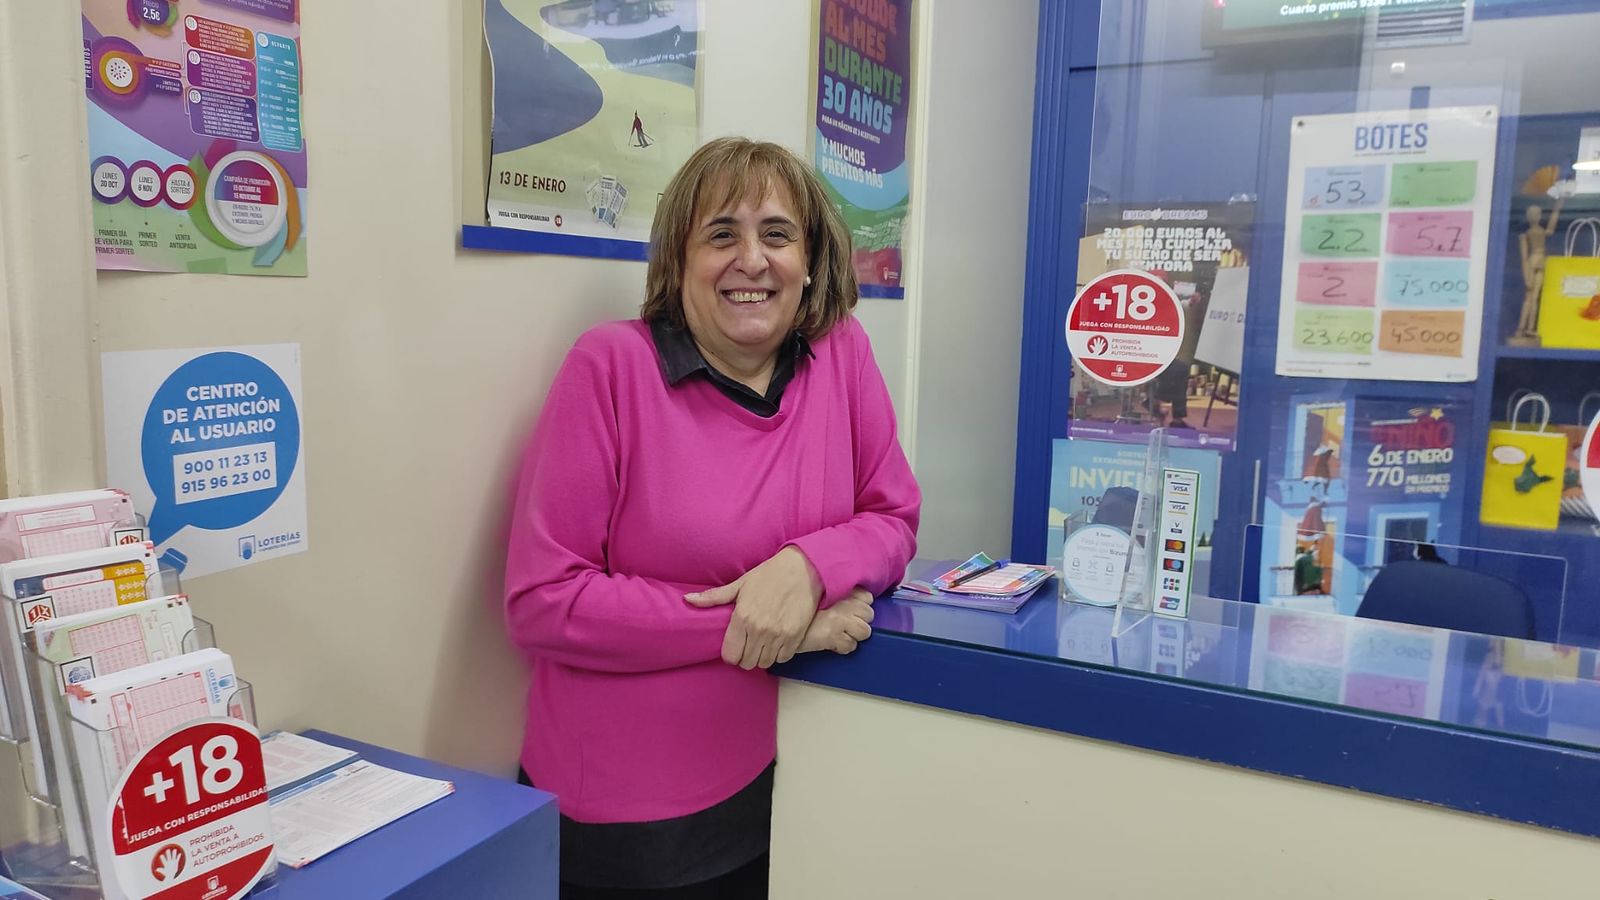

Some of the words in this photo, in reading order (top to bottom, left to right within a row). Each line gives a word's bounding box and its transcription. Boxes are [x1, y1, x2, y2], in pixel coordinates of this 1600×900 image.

[1280, 3, 1317, 16] Cuarto
[1318, 0, 1356, 14] premio
[824, 1, 849, 43] AL
[852, 16, 886, 62] MES
[824, 36, 902, 105] DURANTE
[822, 75, 847, 114] 30
[849, 86, 893, 135] AÑOS
[1354, 122, 1428, 151] BOTES
[821, 137, 828, 154] Y
[829, 138, 866, 167] MUCHOS
[102, 172, 118, 180] LUNES
[138, 176, 153, 184] LUNES
[500, 170, 511, 184] 13
[514, 172, 529, 188] DE
[532, 176, 567, 193] ENERO
[822, 155, 865, 184] PREMIOS
[865, 168, 884, 189] MÁS
[1326, 180, 1366, 204] 53
[1096, 238, 1123, 250] MES
[1126, 238, 1164, 250] PARA
[1165, 238, 1233, 250] CUMPLIR
[1104, 227, 1154, 239] 20.000
[1156, 227, 1204, 238] EUROS
[1204, 227, 1226, 238] AL
[1104, 249, 1122, 260] TU
[1172, 250, 1192, 260] DE
[1193, 250, 1222, 261] SER
[1322, 276, 1347, 298] 2
[1093, 284, 1156, 321] +18
[1079, 320, 1099, 328] JUEGA
[1114, 323, 1170, 332] RESPONSABILIDAD
[186, 382, 258, 402] CENTRO
[162, 408, 189, 425] DE
[193, 396, 280, 422] ATENCIÓN
[170, 428, 196, 444] AL
[199, 418, 277, 440] USUARIO
[184, 460, 214, 474] 900
[218, 456, 230, 468] 11
[234, 454, 250, 467] 23
[254, 451, 267, 464] 13
[1368, 444, 1384, 466] 6
[1385, 450, 1405, 465] DE
[1406, 448, 1454, 464] ENERO
[182, 479, 206, 494] 915
[210, 475, 228, 489] 96
[232, 472, 249, 485] 23
[252, 468, 271, 482] 00
[1366, 466, 1405, 488] 770
[143, 734, 244, 805] +18
[128, 826, 162, 844] JUEGA
[164, 816, 186, 831] CON
[190, 824, 235, 846] PROHIBIDA
[192, 849, 202, 857] LA
[204, 836, 232, 852] VENTA
[193, 833, 265, 867] AUTOPROHIBIDOS
